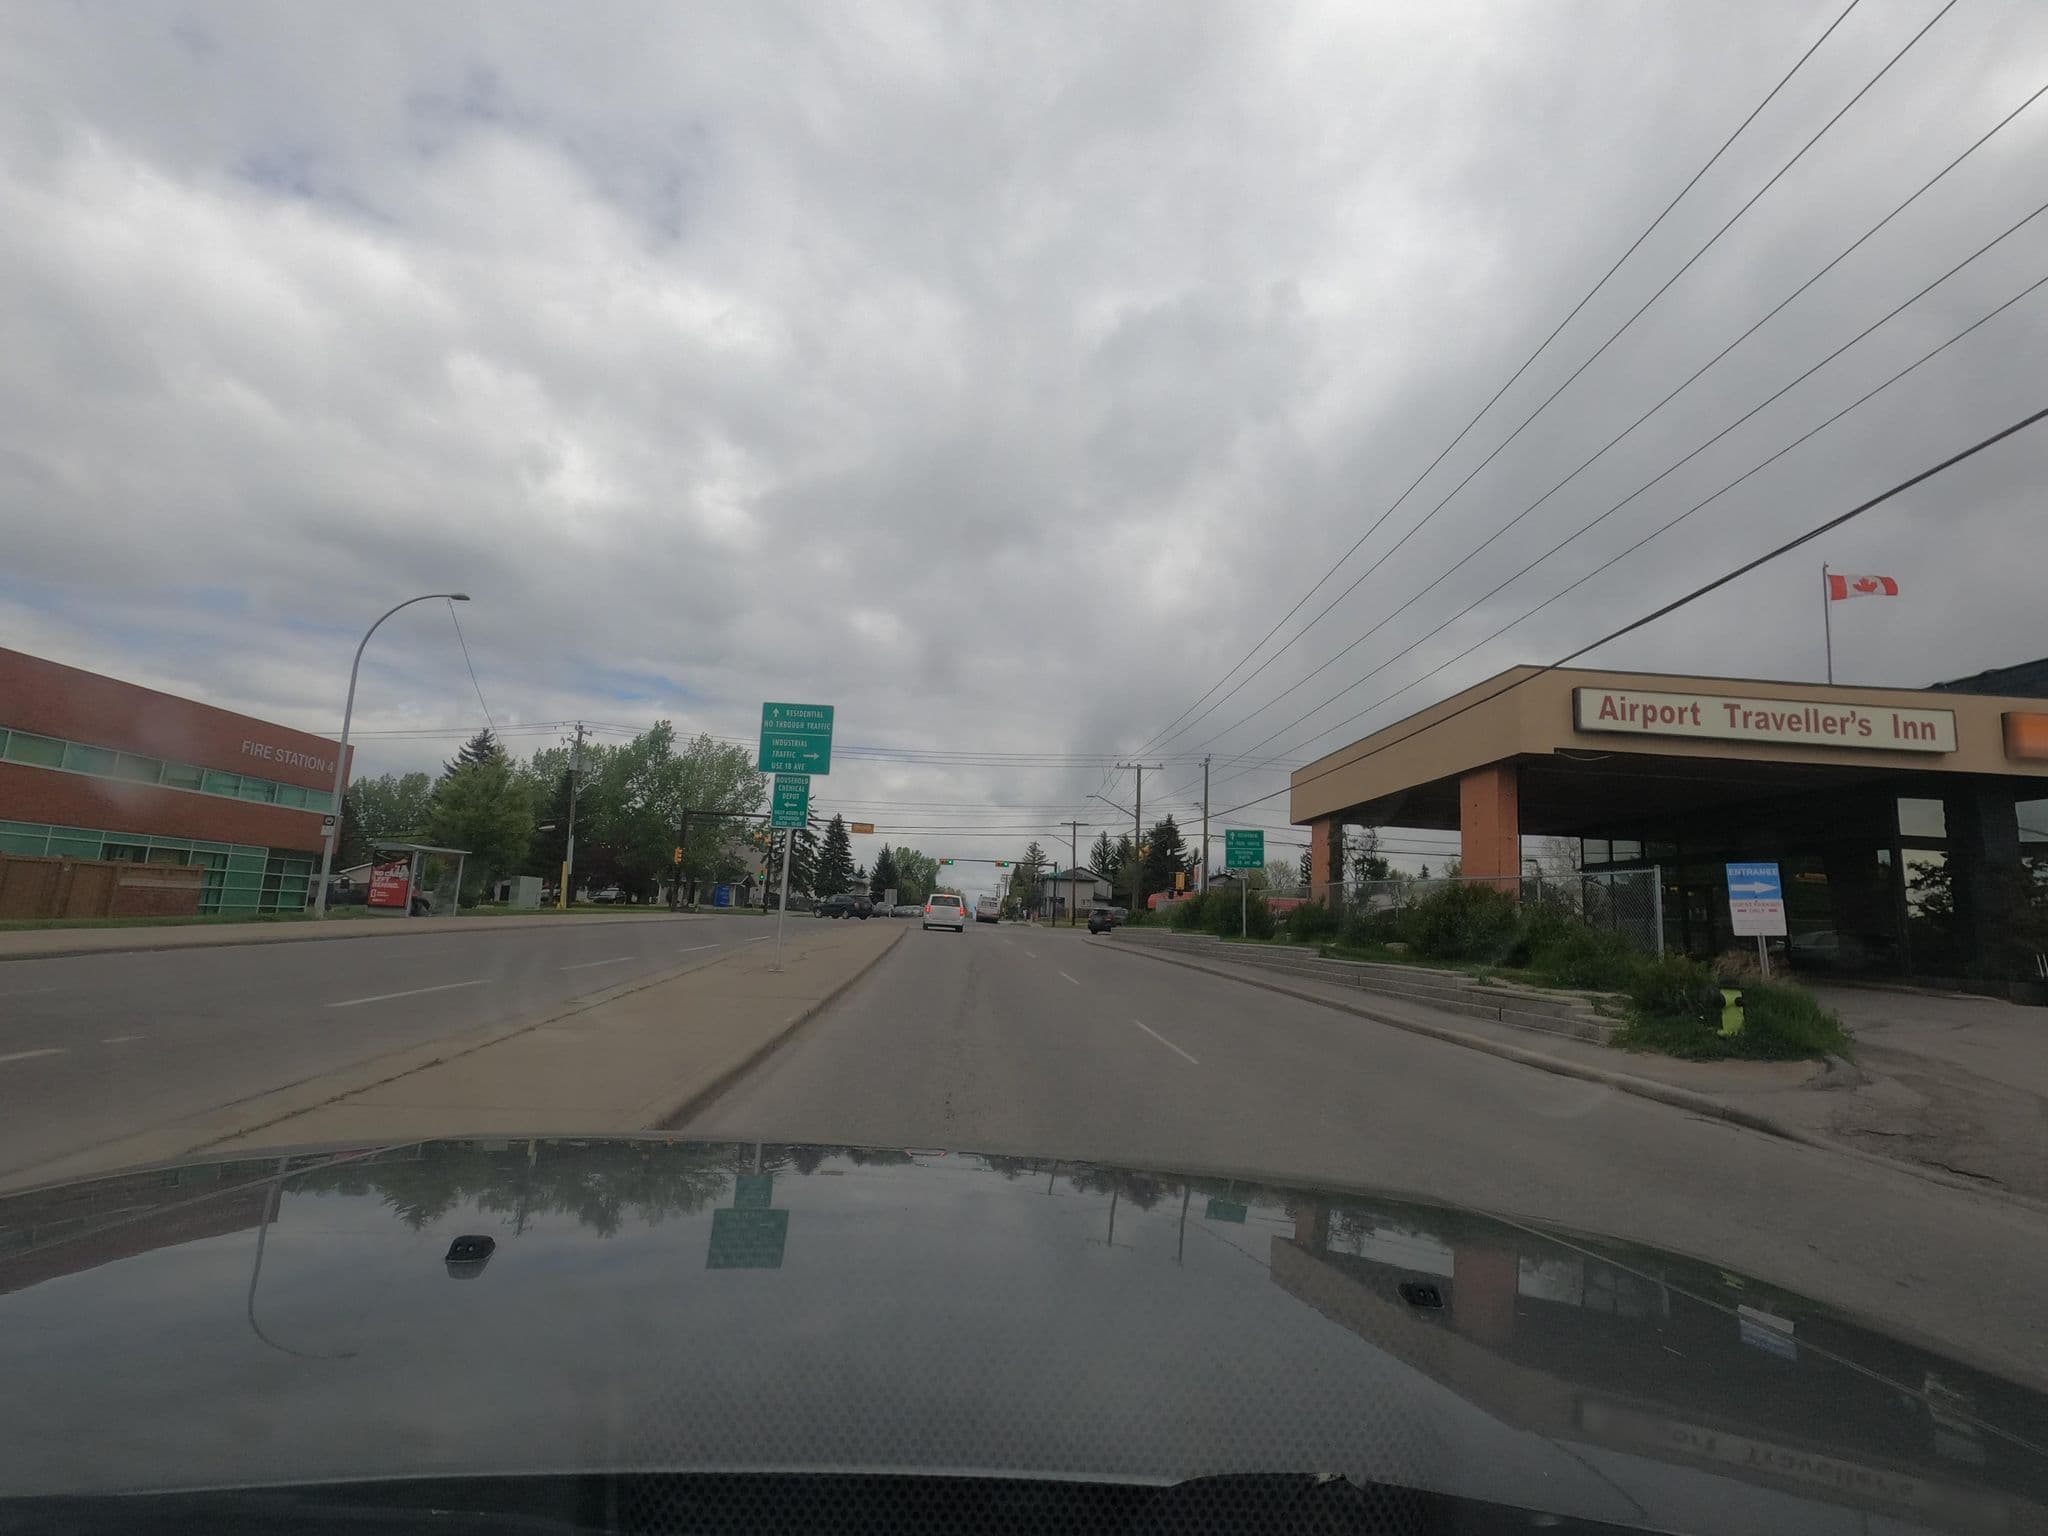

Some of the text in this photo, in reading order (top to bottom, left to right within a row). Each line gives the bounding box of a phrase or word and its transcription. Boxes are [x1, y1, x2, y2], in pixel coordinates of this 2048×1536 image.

[786, 709, 824, 719] RESIDENTIAL
[1599, 695, 1936, 741] Airport Traveller's Inn
[764, 720, 831, 730] NO THROUGH TRAFFIC
[772, 739, 808, 748] INDUSTRIAL
[241, 740, 334, 773] FIRE STATION 4
[772, 750, 797, 759] TRAFFIC
[771, 762, 783, 770] USE
[793, 763, 805, 771] AVE
[1728, 867, 1778, 876] ENTRANCE
